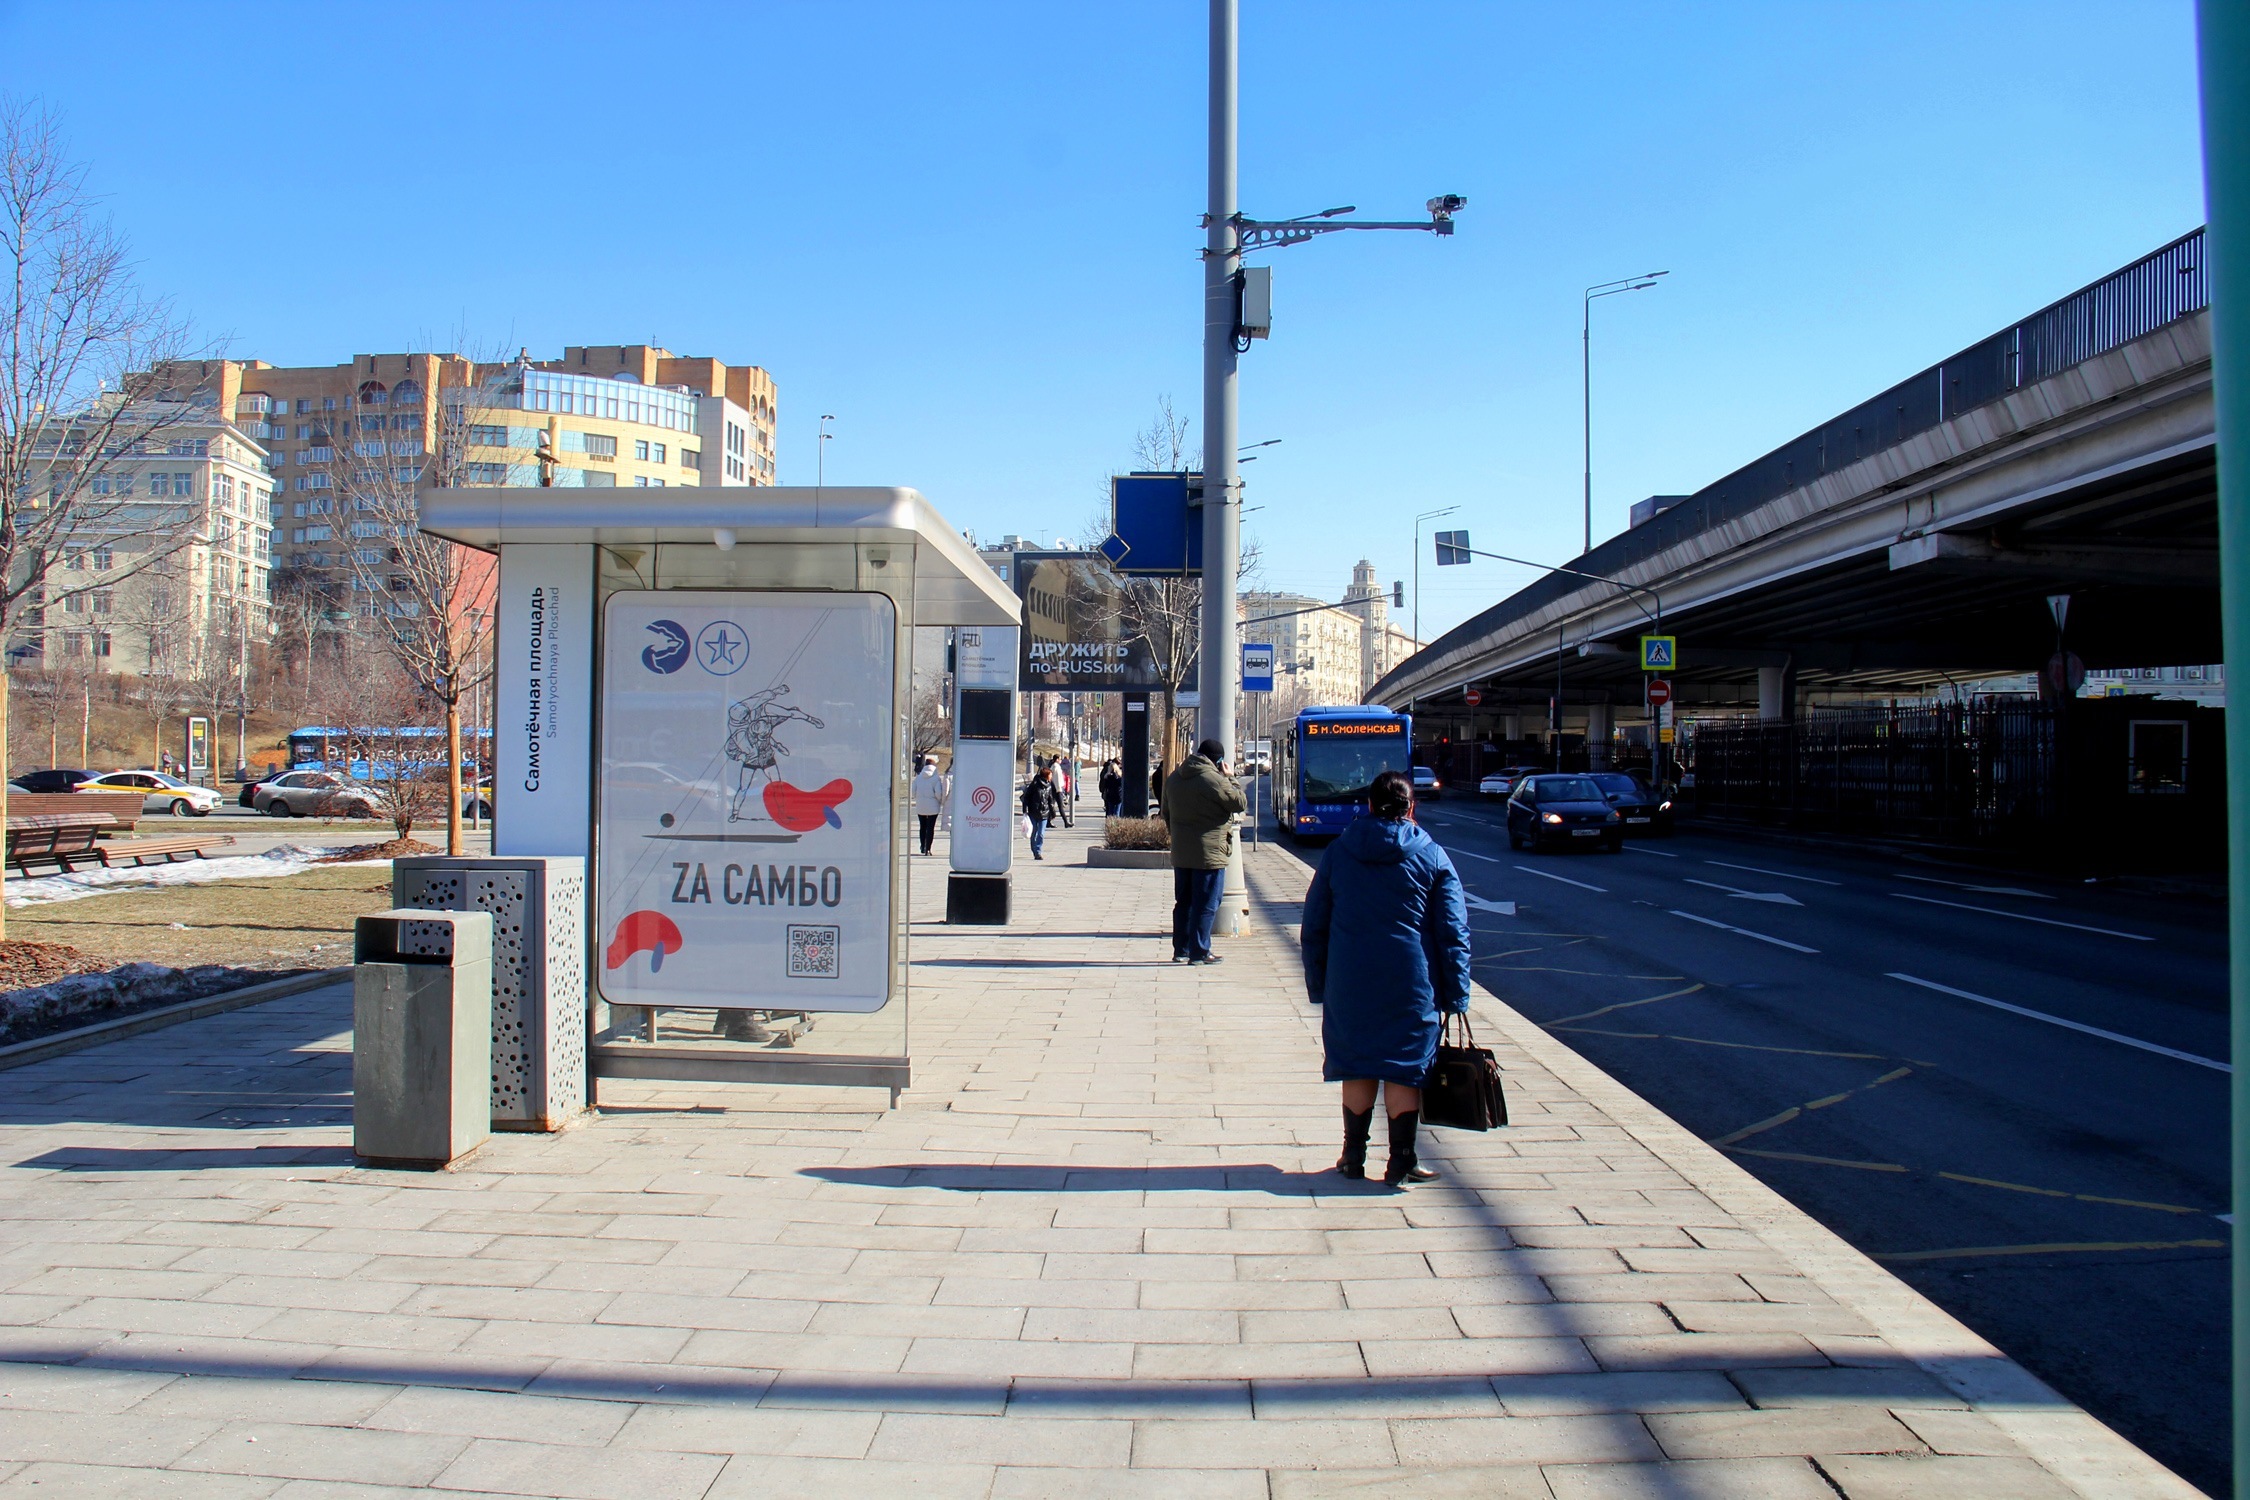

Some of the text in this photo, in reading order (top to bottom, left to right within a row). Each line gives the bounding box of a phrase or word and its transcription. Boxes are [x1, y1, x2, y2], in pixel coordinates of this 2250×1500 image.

[1029, 643, 1129, 659] ДРУЖИТЬ
[547, 586, 560, 738] Samotyochnaya Ploschad
[1030, 660, 1124, 674] по-RUSSки
[524, 586, 545, 793] Самотёчная площадь
[1308, 724, 1319, 735] Б
[968, 821, 999, 829] Транспорт
[671, 862, 842, 908] ZA САМБО
